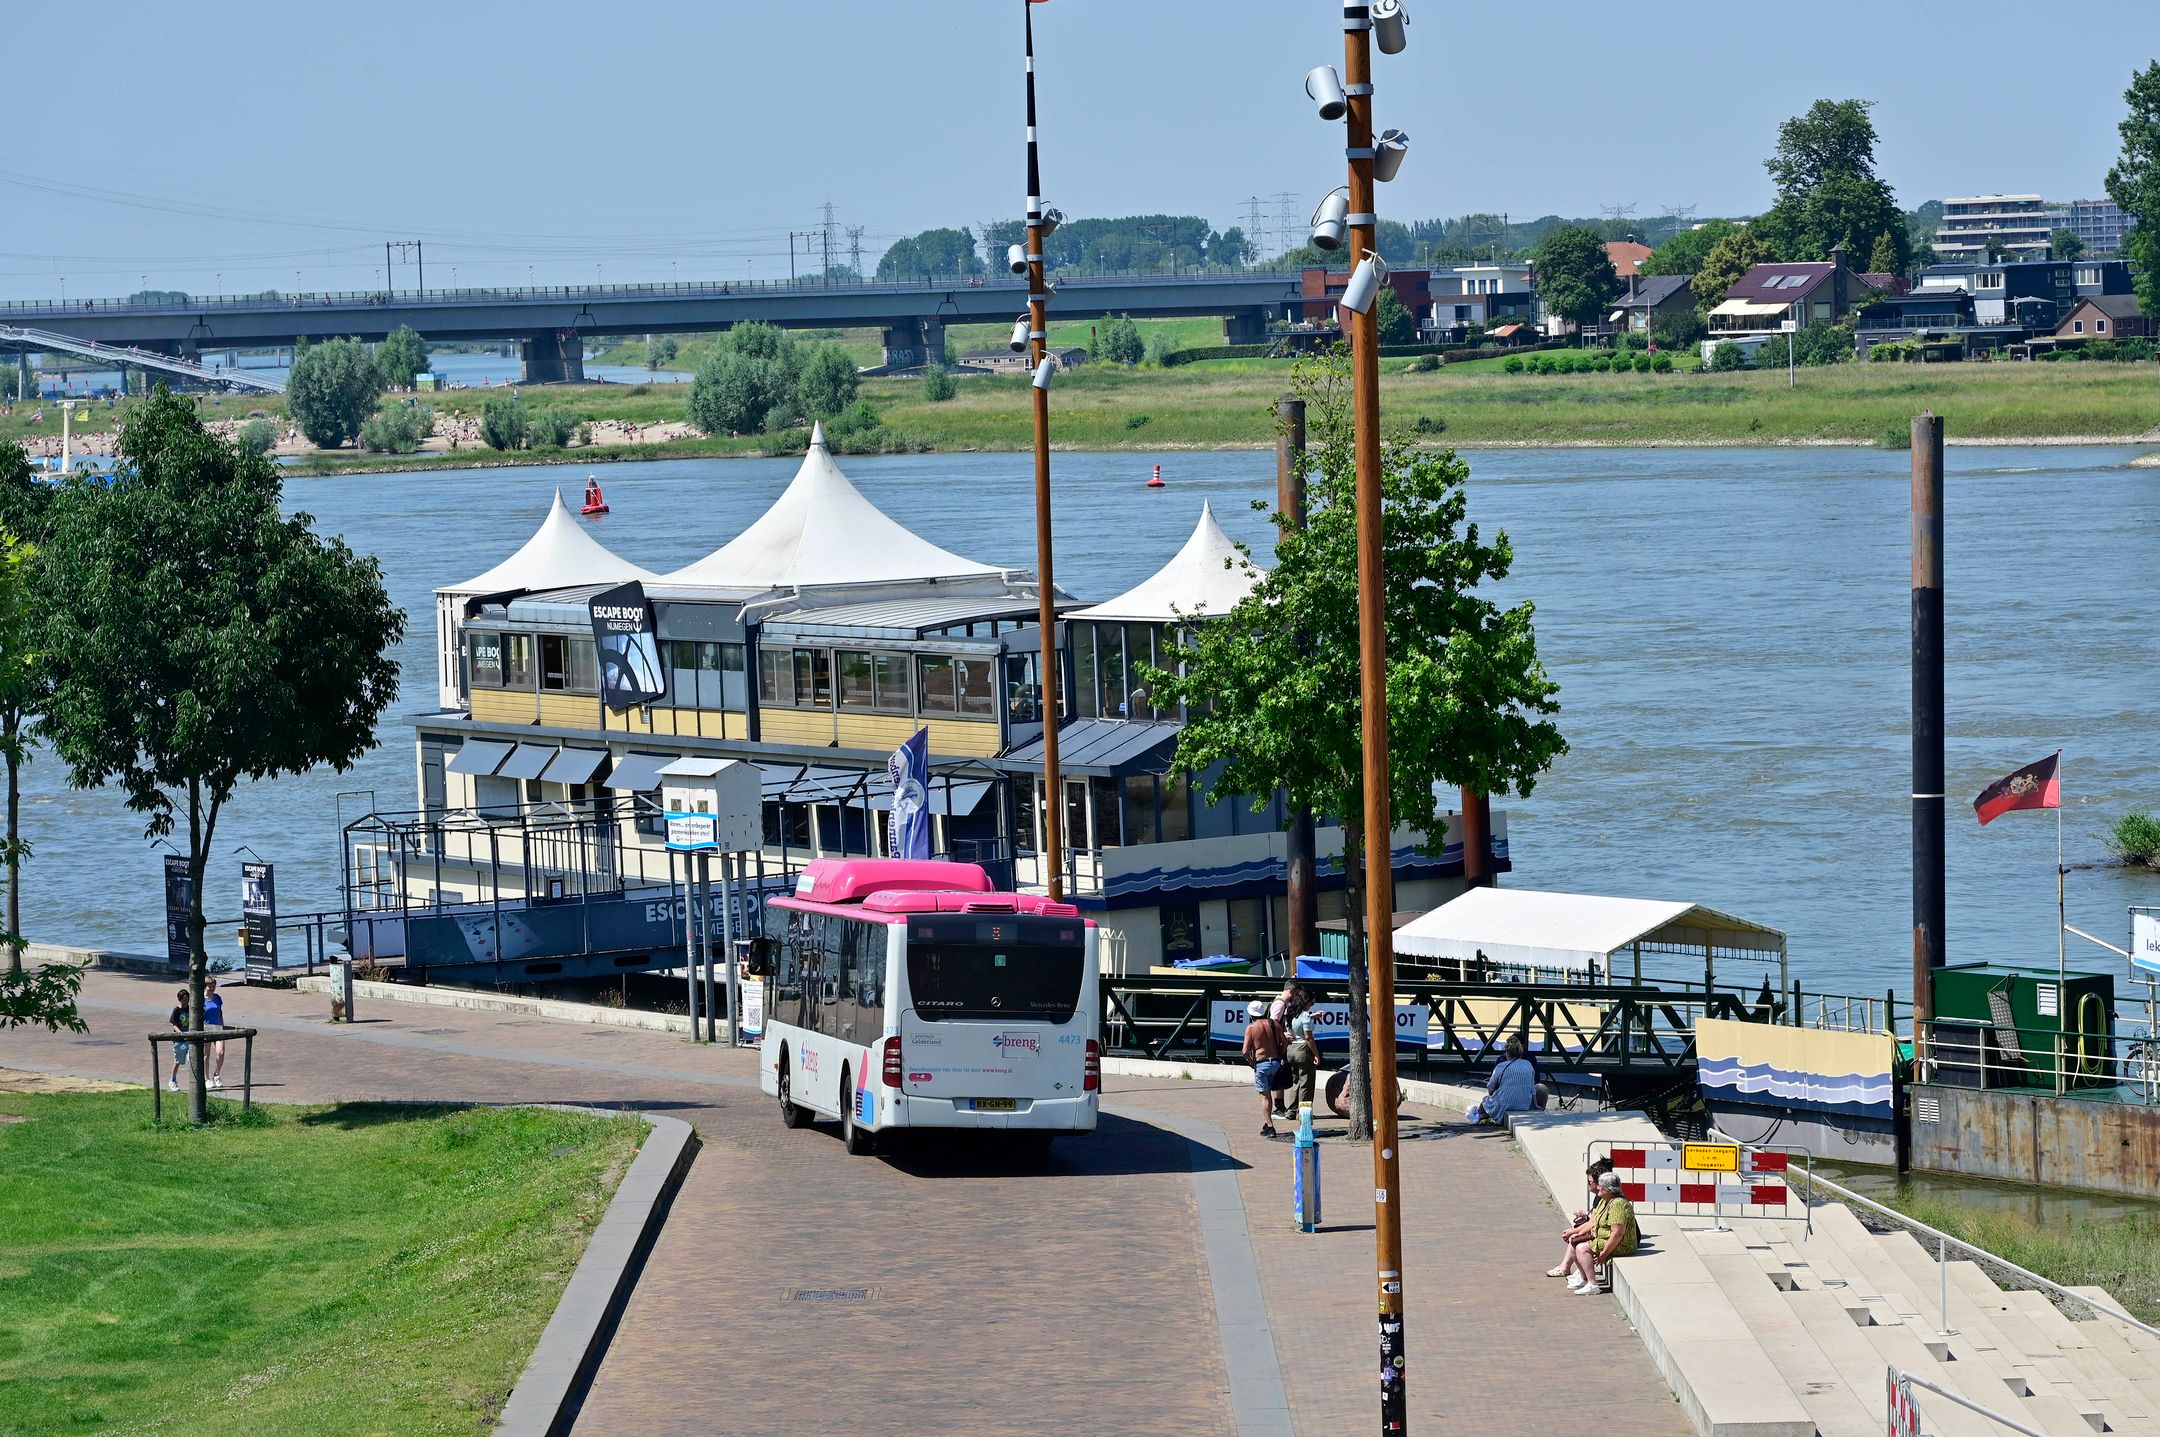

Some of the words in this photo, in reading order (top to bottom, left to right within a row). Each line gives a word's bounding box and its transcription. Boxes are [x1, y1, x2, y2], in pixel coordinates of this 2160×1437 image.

[593, 606, 622, 619] ESCAPE
[622, 607, 643, 620] BOOT
[607, 622, 633, 632] NIJMEGEN
[1225, 1010, 1243, 1024] DE
[1004, 1035, 1036, 1050] breng
[1058, 1035, 1081, 1045] 4473
